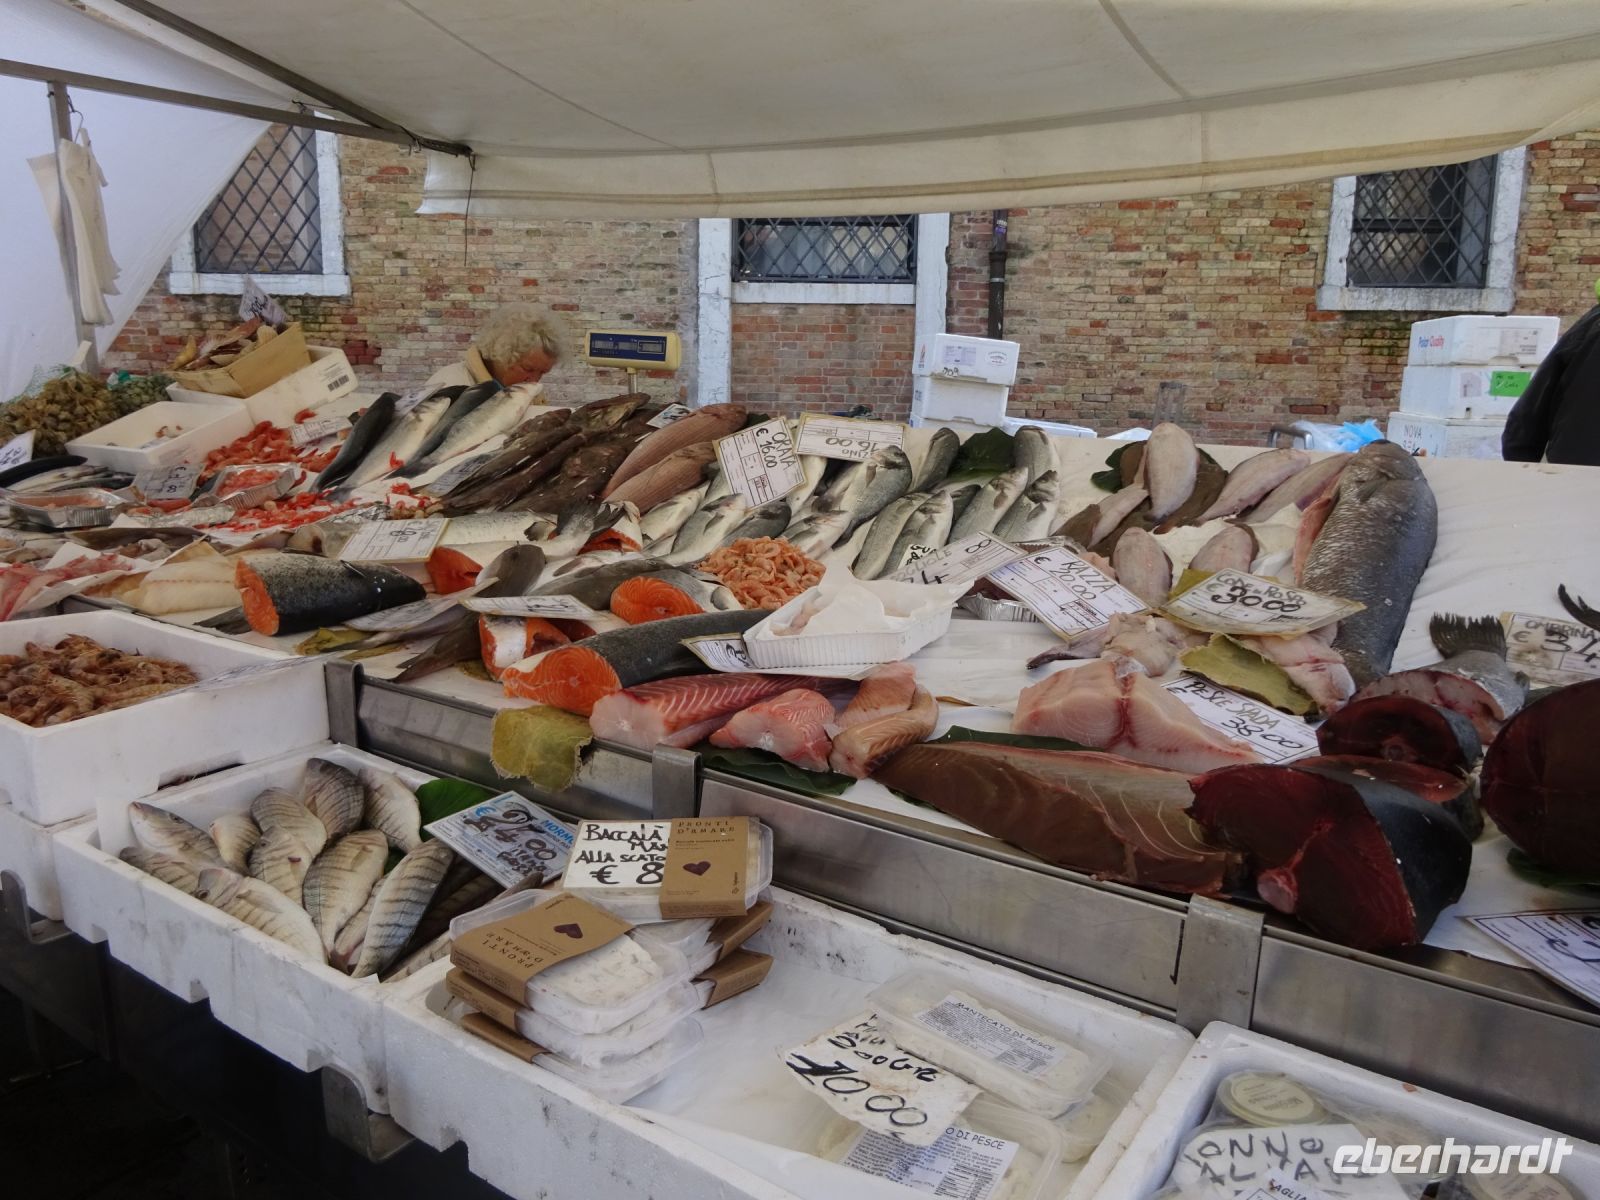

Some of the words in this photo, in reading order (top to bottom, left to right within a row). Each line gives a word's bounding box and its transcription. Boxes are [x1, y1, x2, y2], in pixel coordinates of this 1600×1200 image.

[755, 427, 769, 438] €
[1404, 424, 1422, 439] NOVA
[771, 431, 797, 470] ORATA
[1033, 555, 1052, 566] €
[1061, 560, 1116, 594] RAZZA
[1511, 630, 1532, 643] €
[1184, 681, 1233, 709] PESCE
[1225, 701, 1281, 730] SPADA
[475, 805, 497, 817] €
[583, 823, 664, 842] BACCALÀ
[574, 850, 616, 864] ALLA
[589, 864, 620, 885] €
[955, 1002, 1013, 1032] MANTECATO
[1012, 1029, 1025, 1039] DI
[1026, 1036, 1056, 1051] PESCE
[955, 1131, 969, 1141] DI
[972, 1134, 1006, 1151] PESCE
